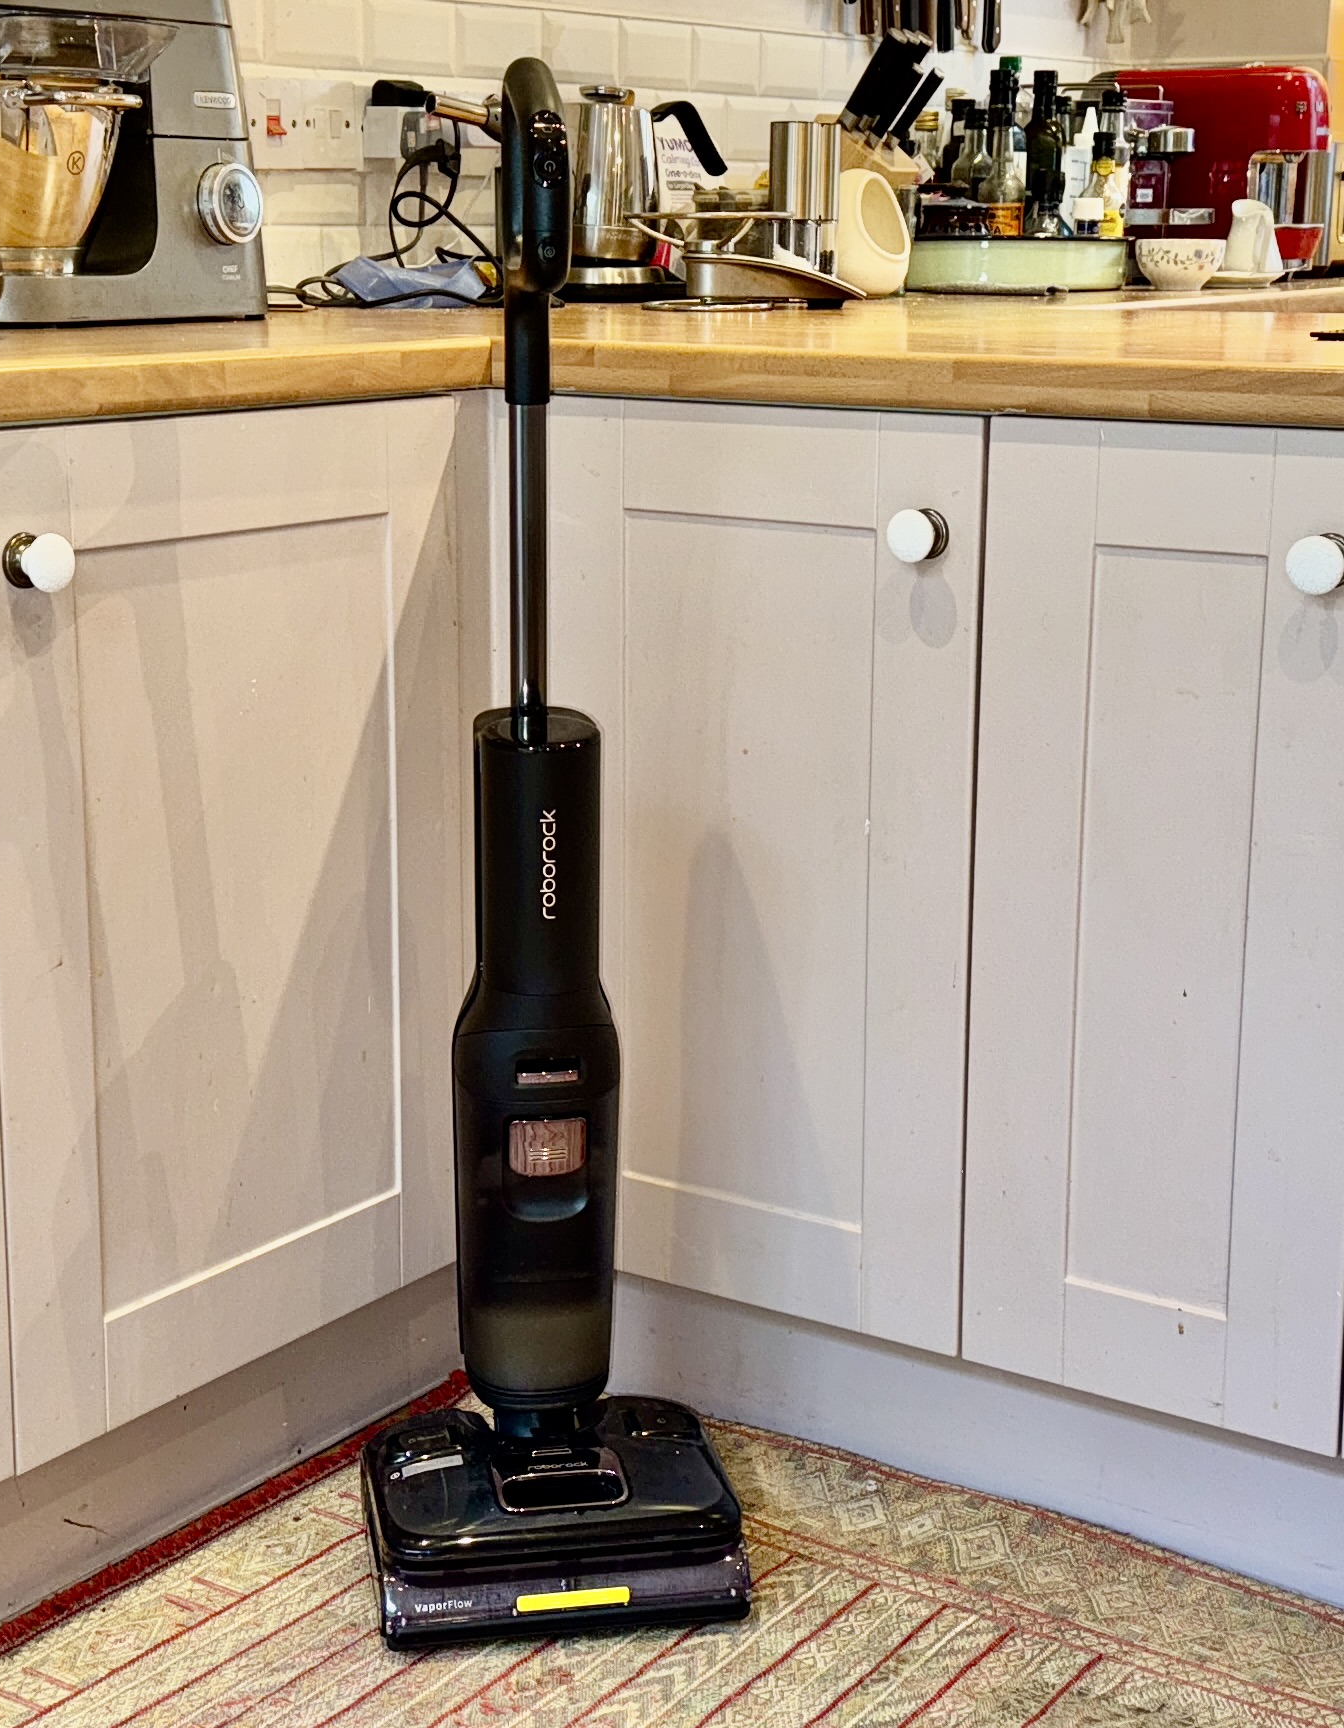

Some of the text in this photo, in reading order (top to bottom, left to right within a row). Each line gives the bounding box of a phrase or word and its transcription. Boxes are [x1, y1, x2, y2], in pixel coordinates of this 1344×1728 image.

[539, 808, 557, 920] roborock
[527, 1460, 589, 1471] roborock
[414, 1599, 474, 1614] VaporFlow
